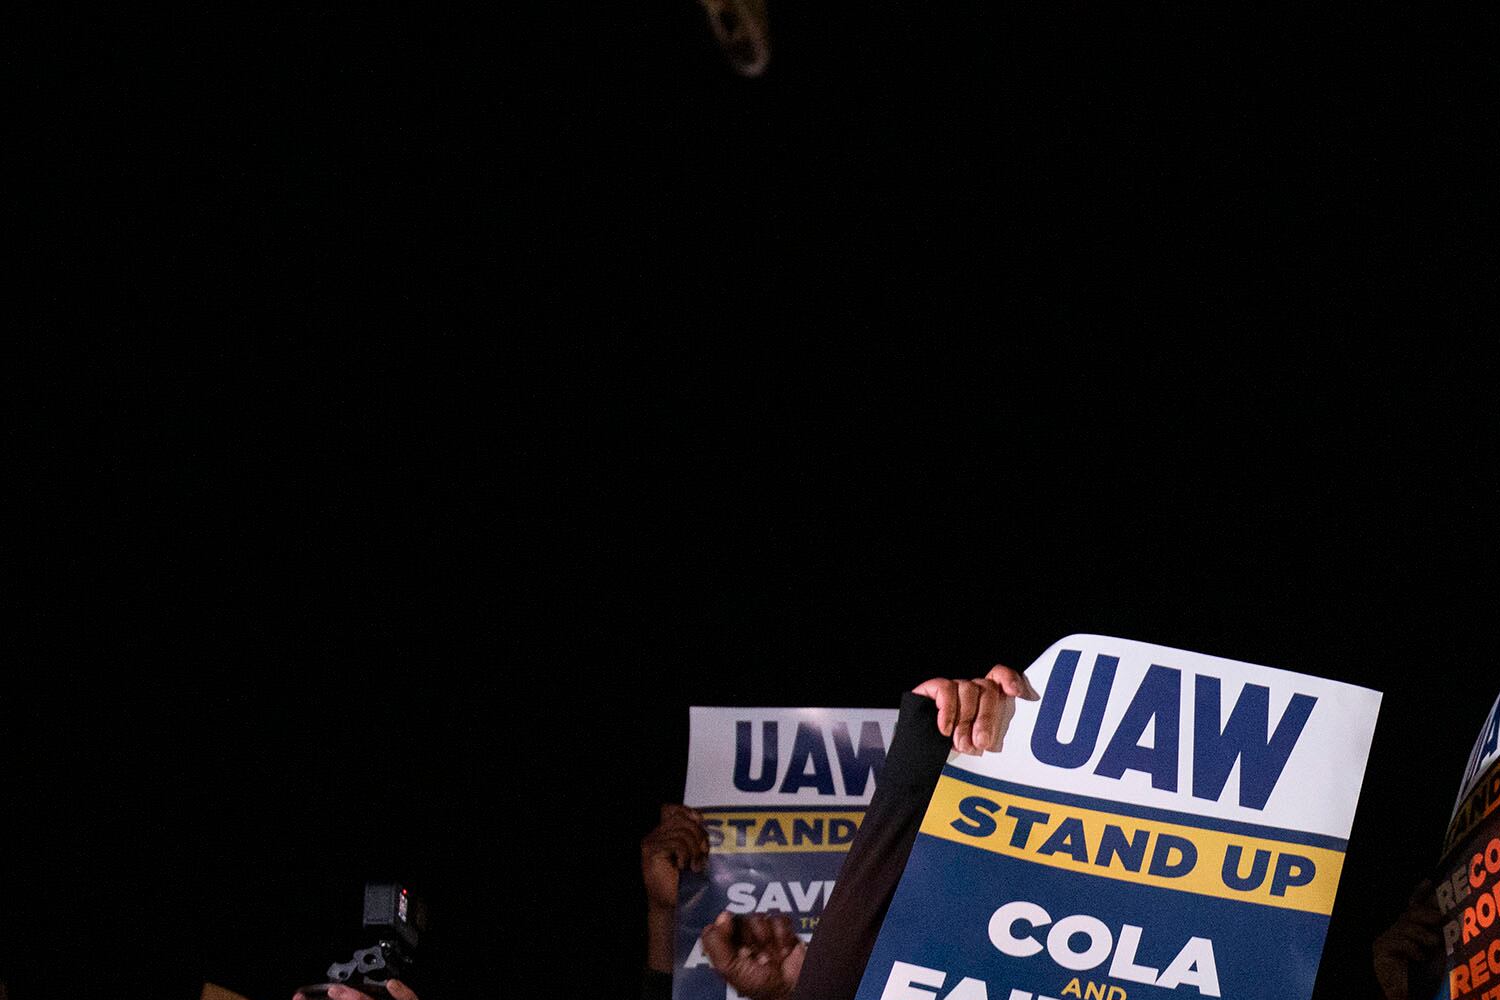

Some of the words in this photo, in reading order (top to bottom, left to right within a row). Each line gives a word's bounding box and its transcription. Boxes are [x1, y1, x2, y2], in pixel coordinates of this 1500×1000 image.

[733, 721, 899, 796] UAW
[1030, 649, 1319, 811] UAW
[703, 818, 857, 848] STAND
[950, 796, 1197, 879] STAND
[1222, 845, 1317, 898] UP
[725, 880, 836, 915] SAVI
[988, 900, 1221, 998] COLA
